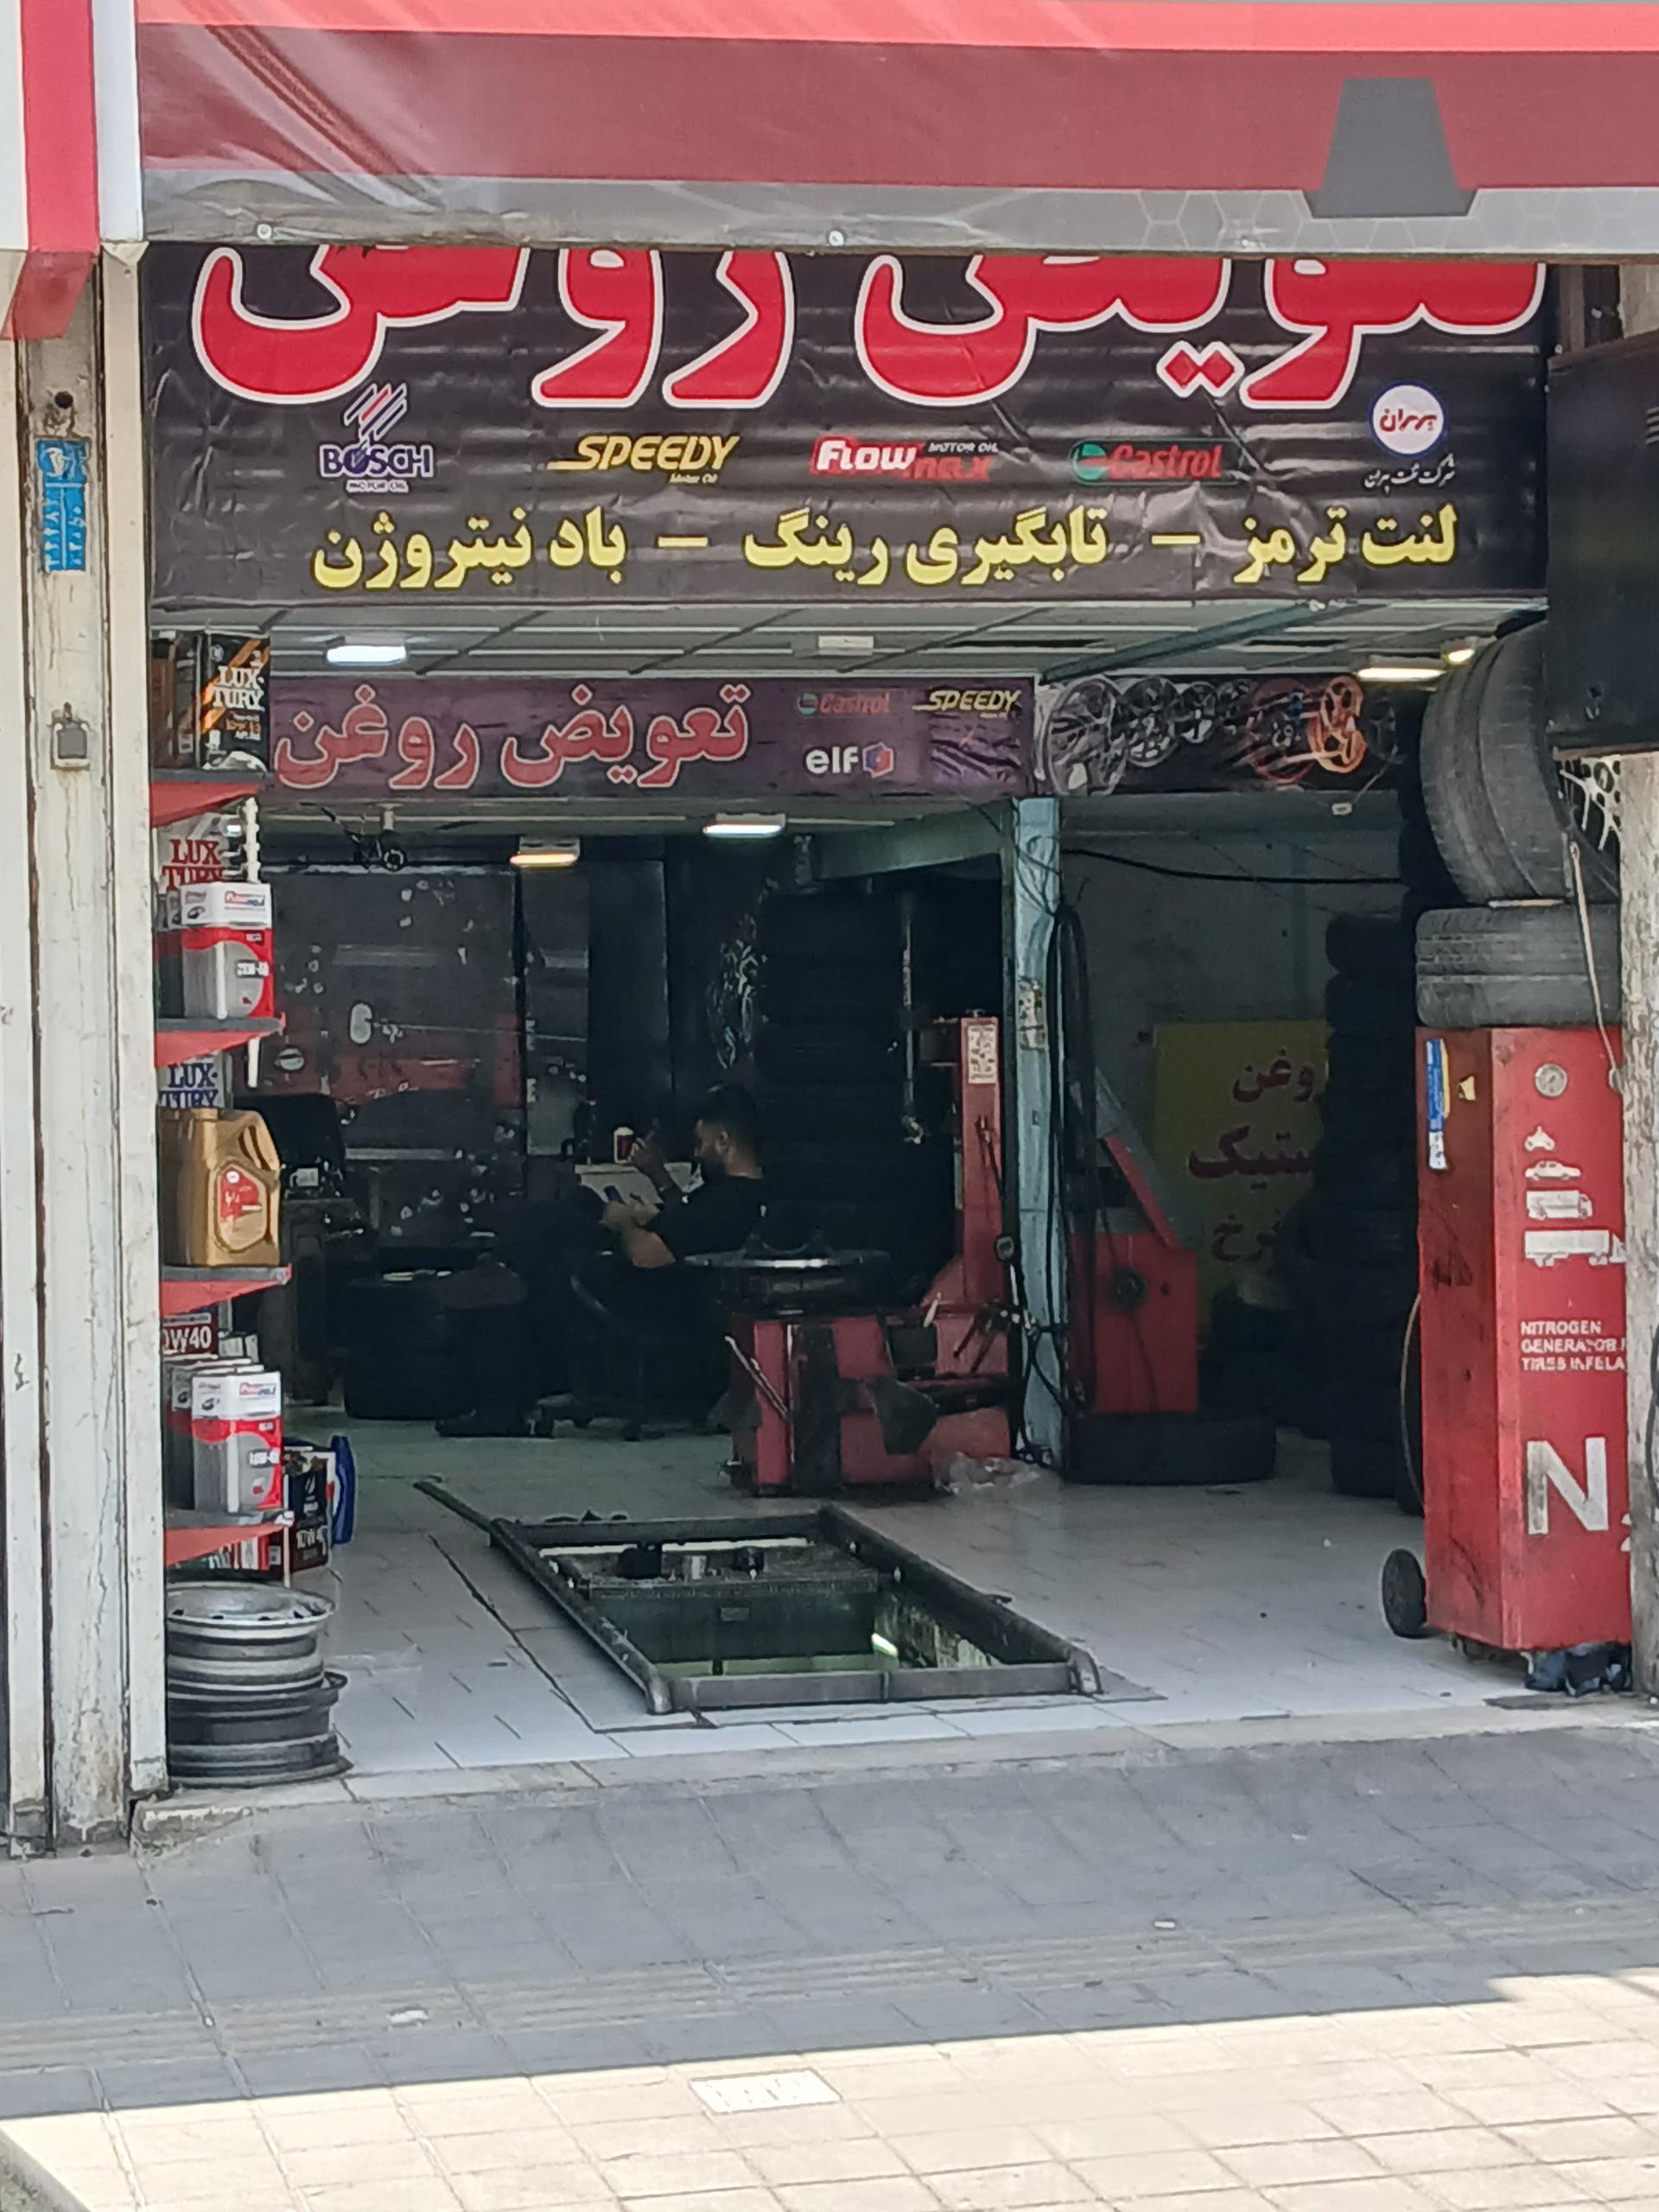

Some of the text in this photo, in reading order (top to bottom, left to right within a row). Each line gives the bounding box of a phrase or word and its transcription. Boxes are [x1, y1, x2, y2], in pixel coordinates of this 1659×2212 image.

[320, 443, 434, 477] BOSCH
[547, 435, 741, 470] SPEEDY
[928, 438, 1000, 453] MOTOR OIL
[1108, 445, 1224, 480] Castrol
[313, 506, 532, 588] نیتروژن
[550, 509, 626, 582] باد
[743, 510, 889, 586] رینگ
[905, 508, 1107, 585] تابگیری
[1236, 508, 1346, 583] ترمز
[1362, 505, 1457, 565] لنت
[912, 690, 1021, 712] SPEEDY
[274, 683, 751, 789] تعویض روغن
[805, 746, 860, 774] elf
[1232, 1047, 1317, 1103] وغن
[1520, 1320, 1602, 1336] NITROGEN
[1569, 1356, 1626, 1371] INFELA
[1526, 1436, 1631, 1553] N
